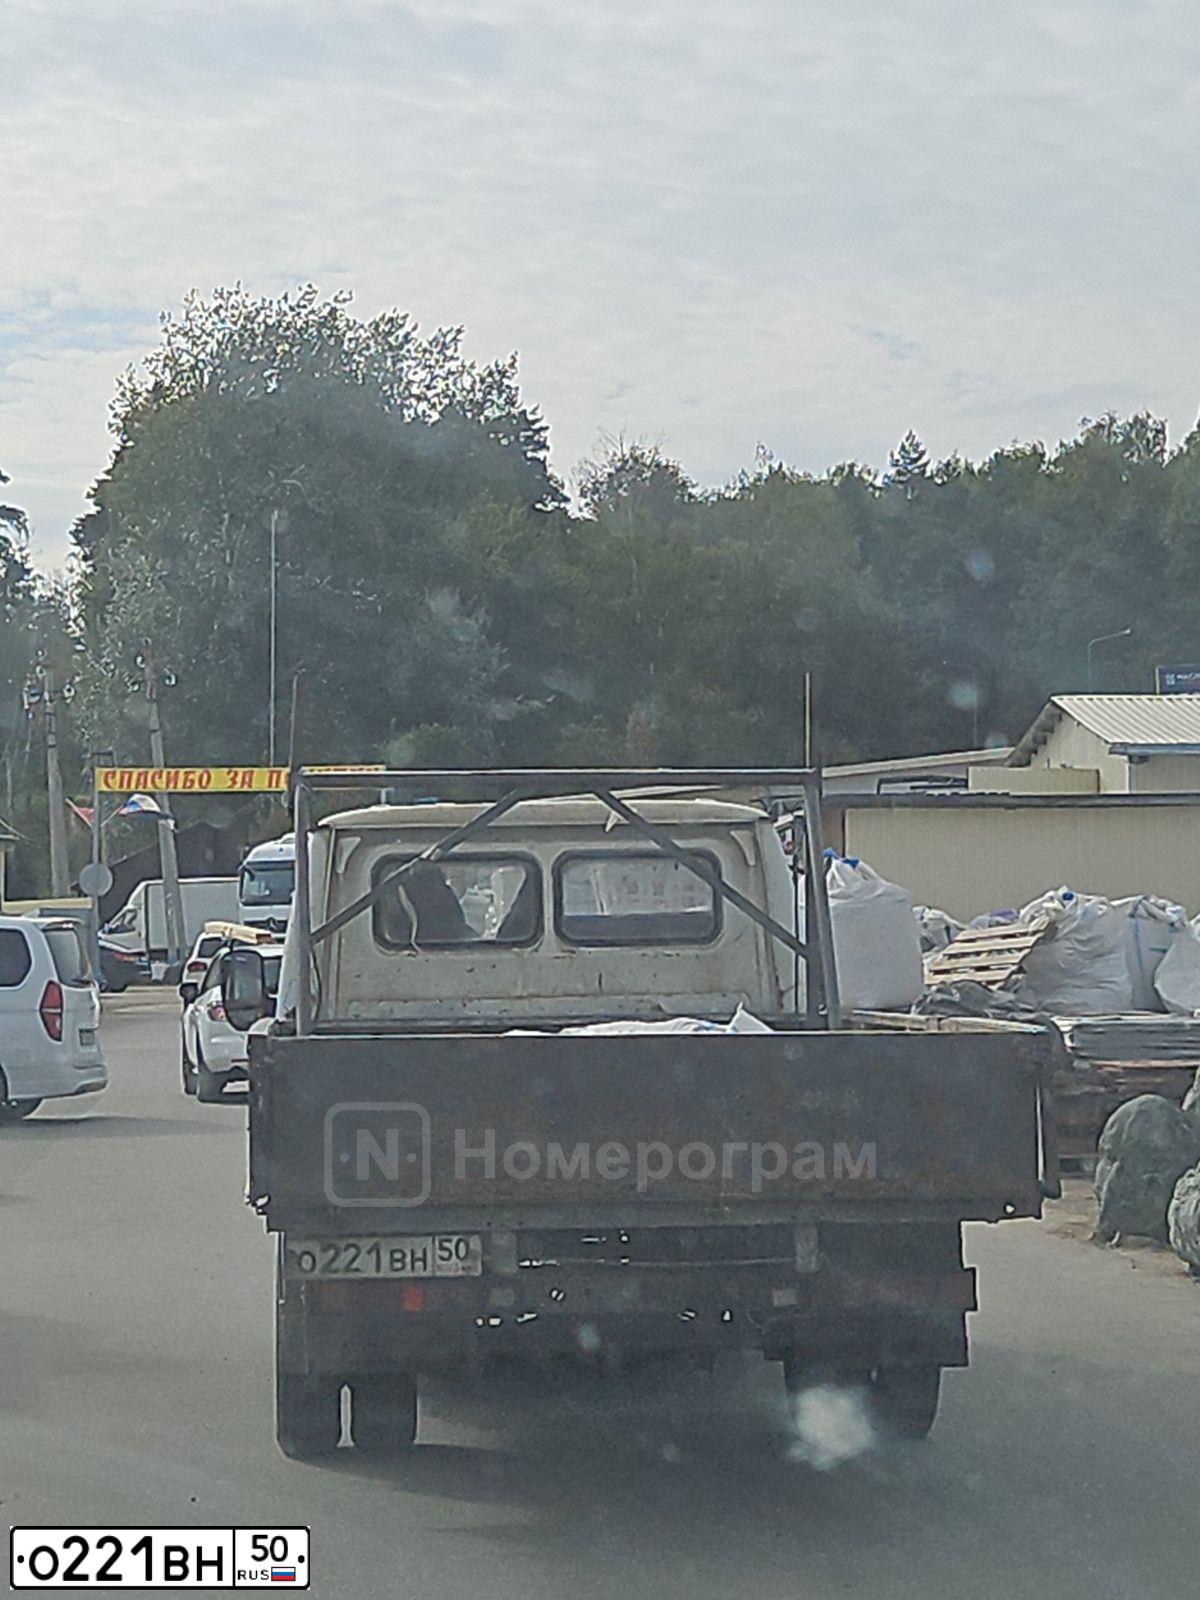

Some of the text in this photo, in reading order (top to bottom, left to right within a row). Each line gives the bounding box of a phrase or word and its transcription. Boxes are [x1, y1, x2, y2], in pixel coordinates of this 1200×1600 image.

[102, 768, 212, 790] СПАСИБО
[226, 768, 256, 789] ЗА
[437, 1238, 471, 1262] 50
